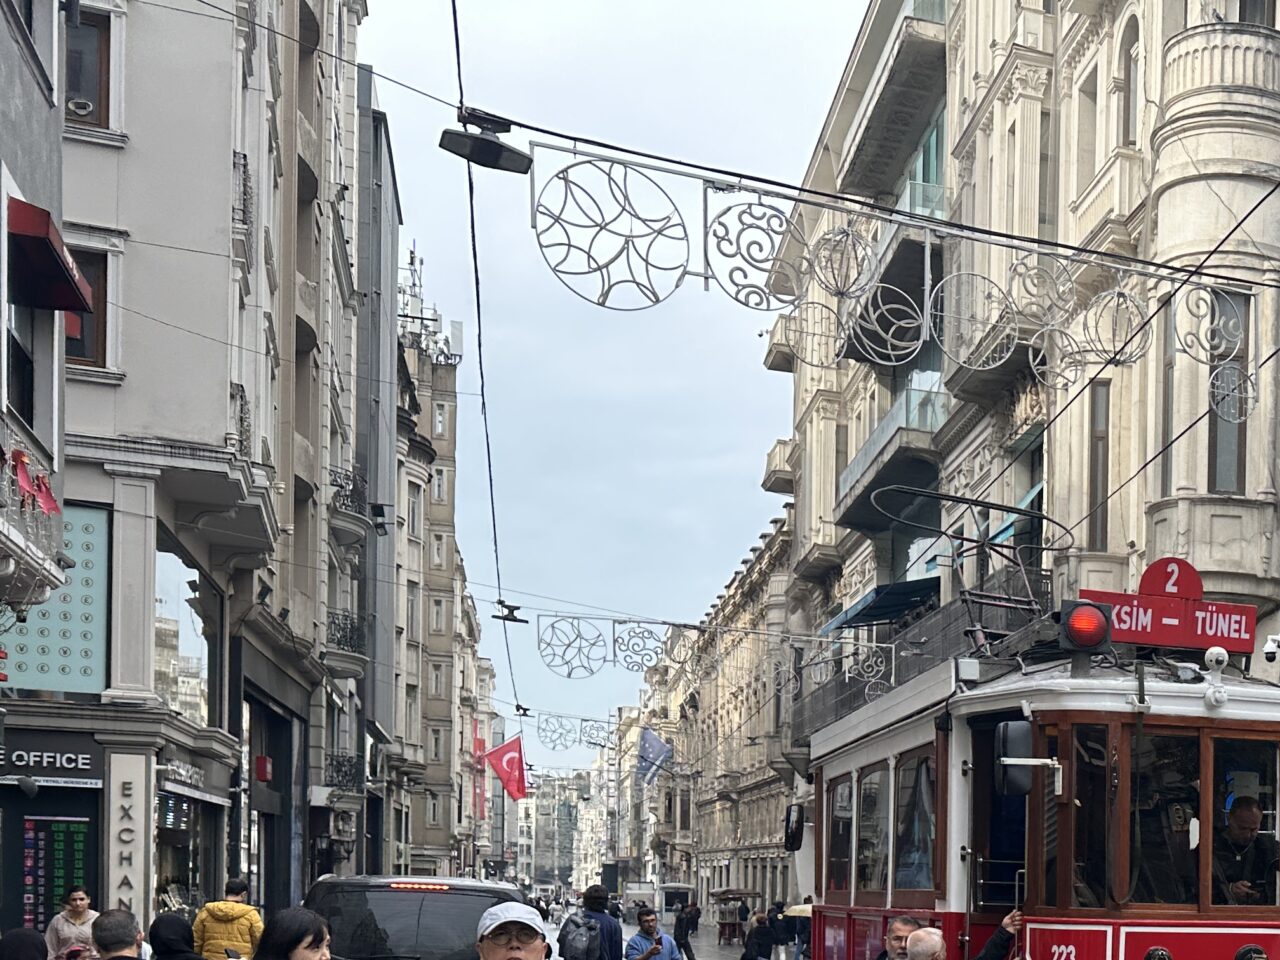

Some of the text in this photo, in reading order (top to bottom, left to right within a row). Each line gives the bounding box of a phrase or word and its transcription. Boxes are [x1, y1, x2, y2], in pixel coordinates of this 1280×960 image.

[1165, 563, 1179, 593] 2
[1195, 605, 1250, 640] TÜNEL
[12, 751, 91, 769] OFFICE
